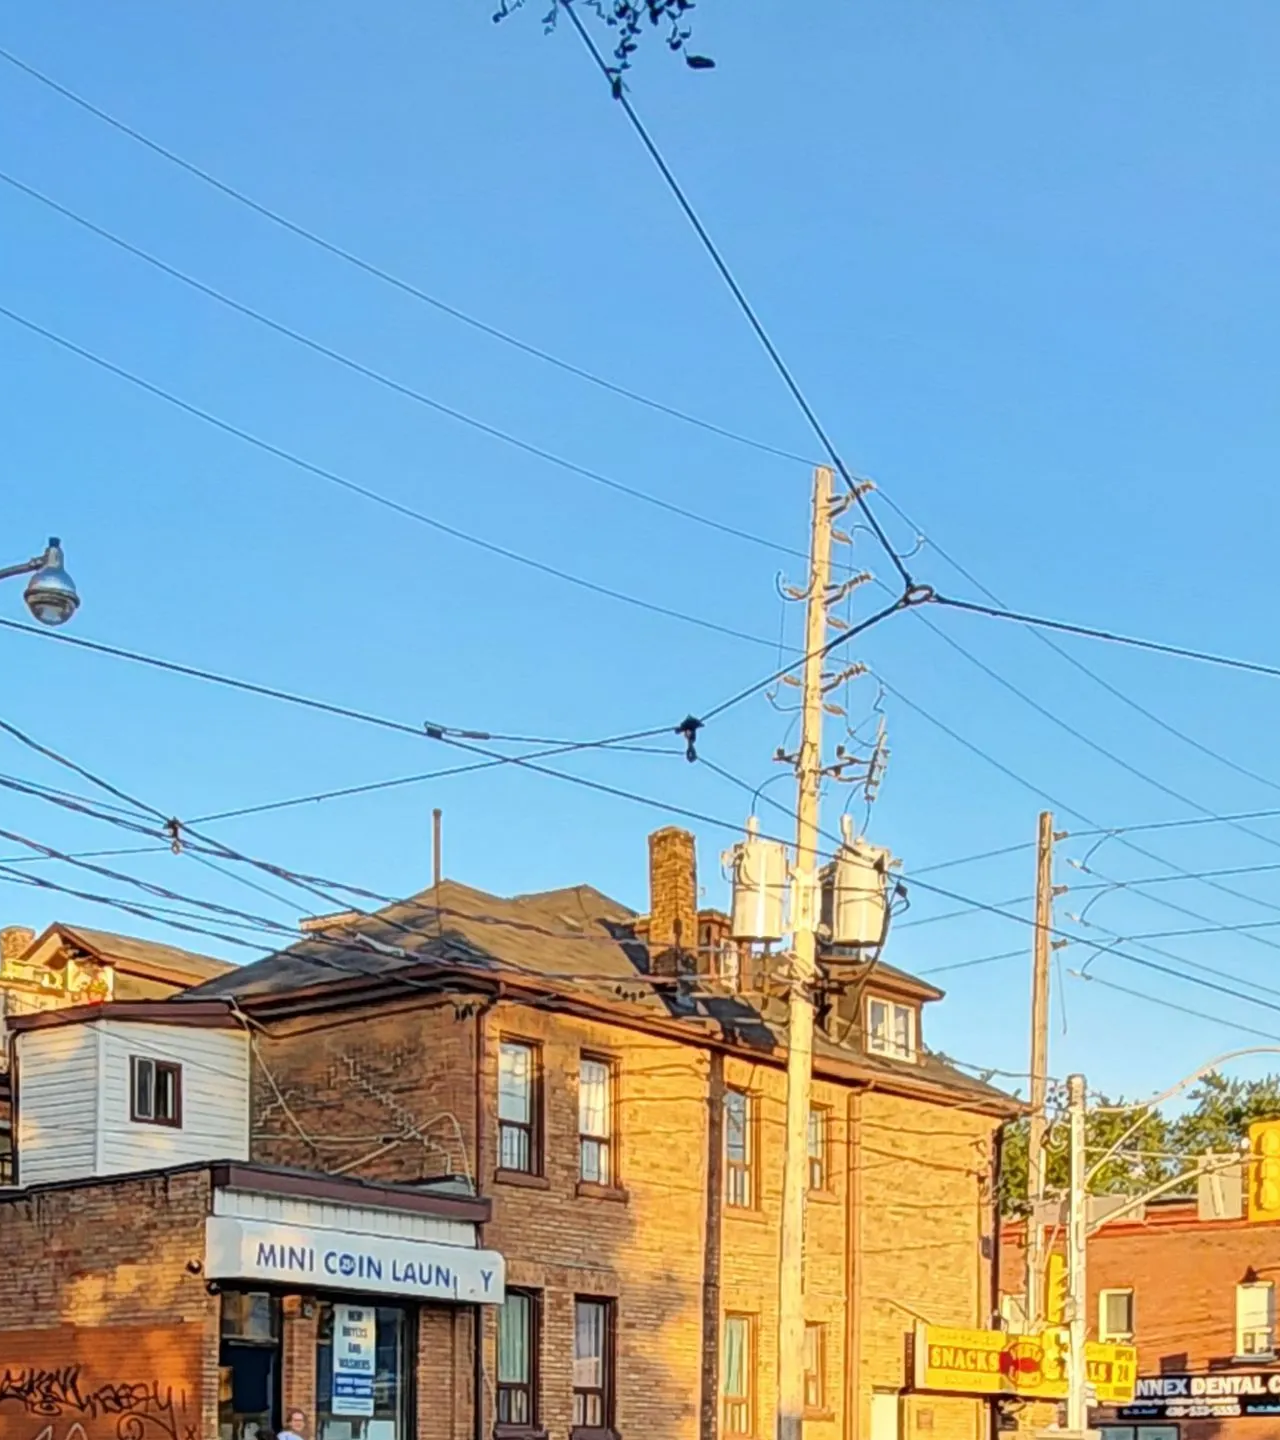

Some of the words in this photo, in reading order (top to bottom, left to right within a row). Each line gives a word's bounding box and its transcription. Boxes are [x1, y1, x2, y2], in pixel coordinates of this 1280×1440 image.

[256, 1242, 314, 1273] MINI
[324, 1251, 382, 1280] COIN
[930, 1346, 1000, 1371] SNACKS
[1136, 1377, 1188, 1397] NNEX
[1190, 1375, 1267, 1396] DENTAL
